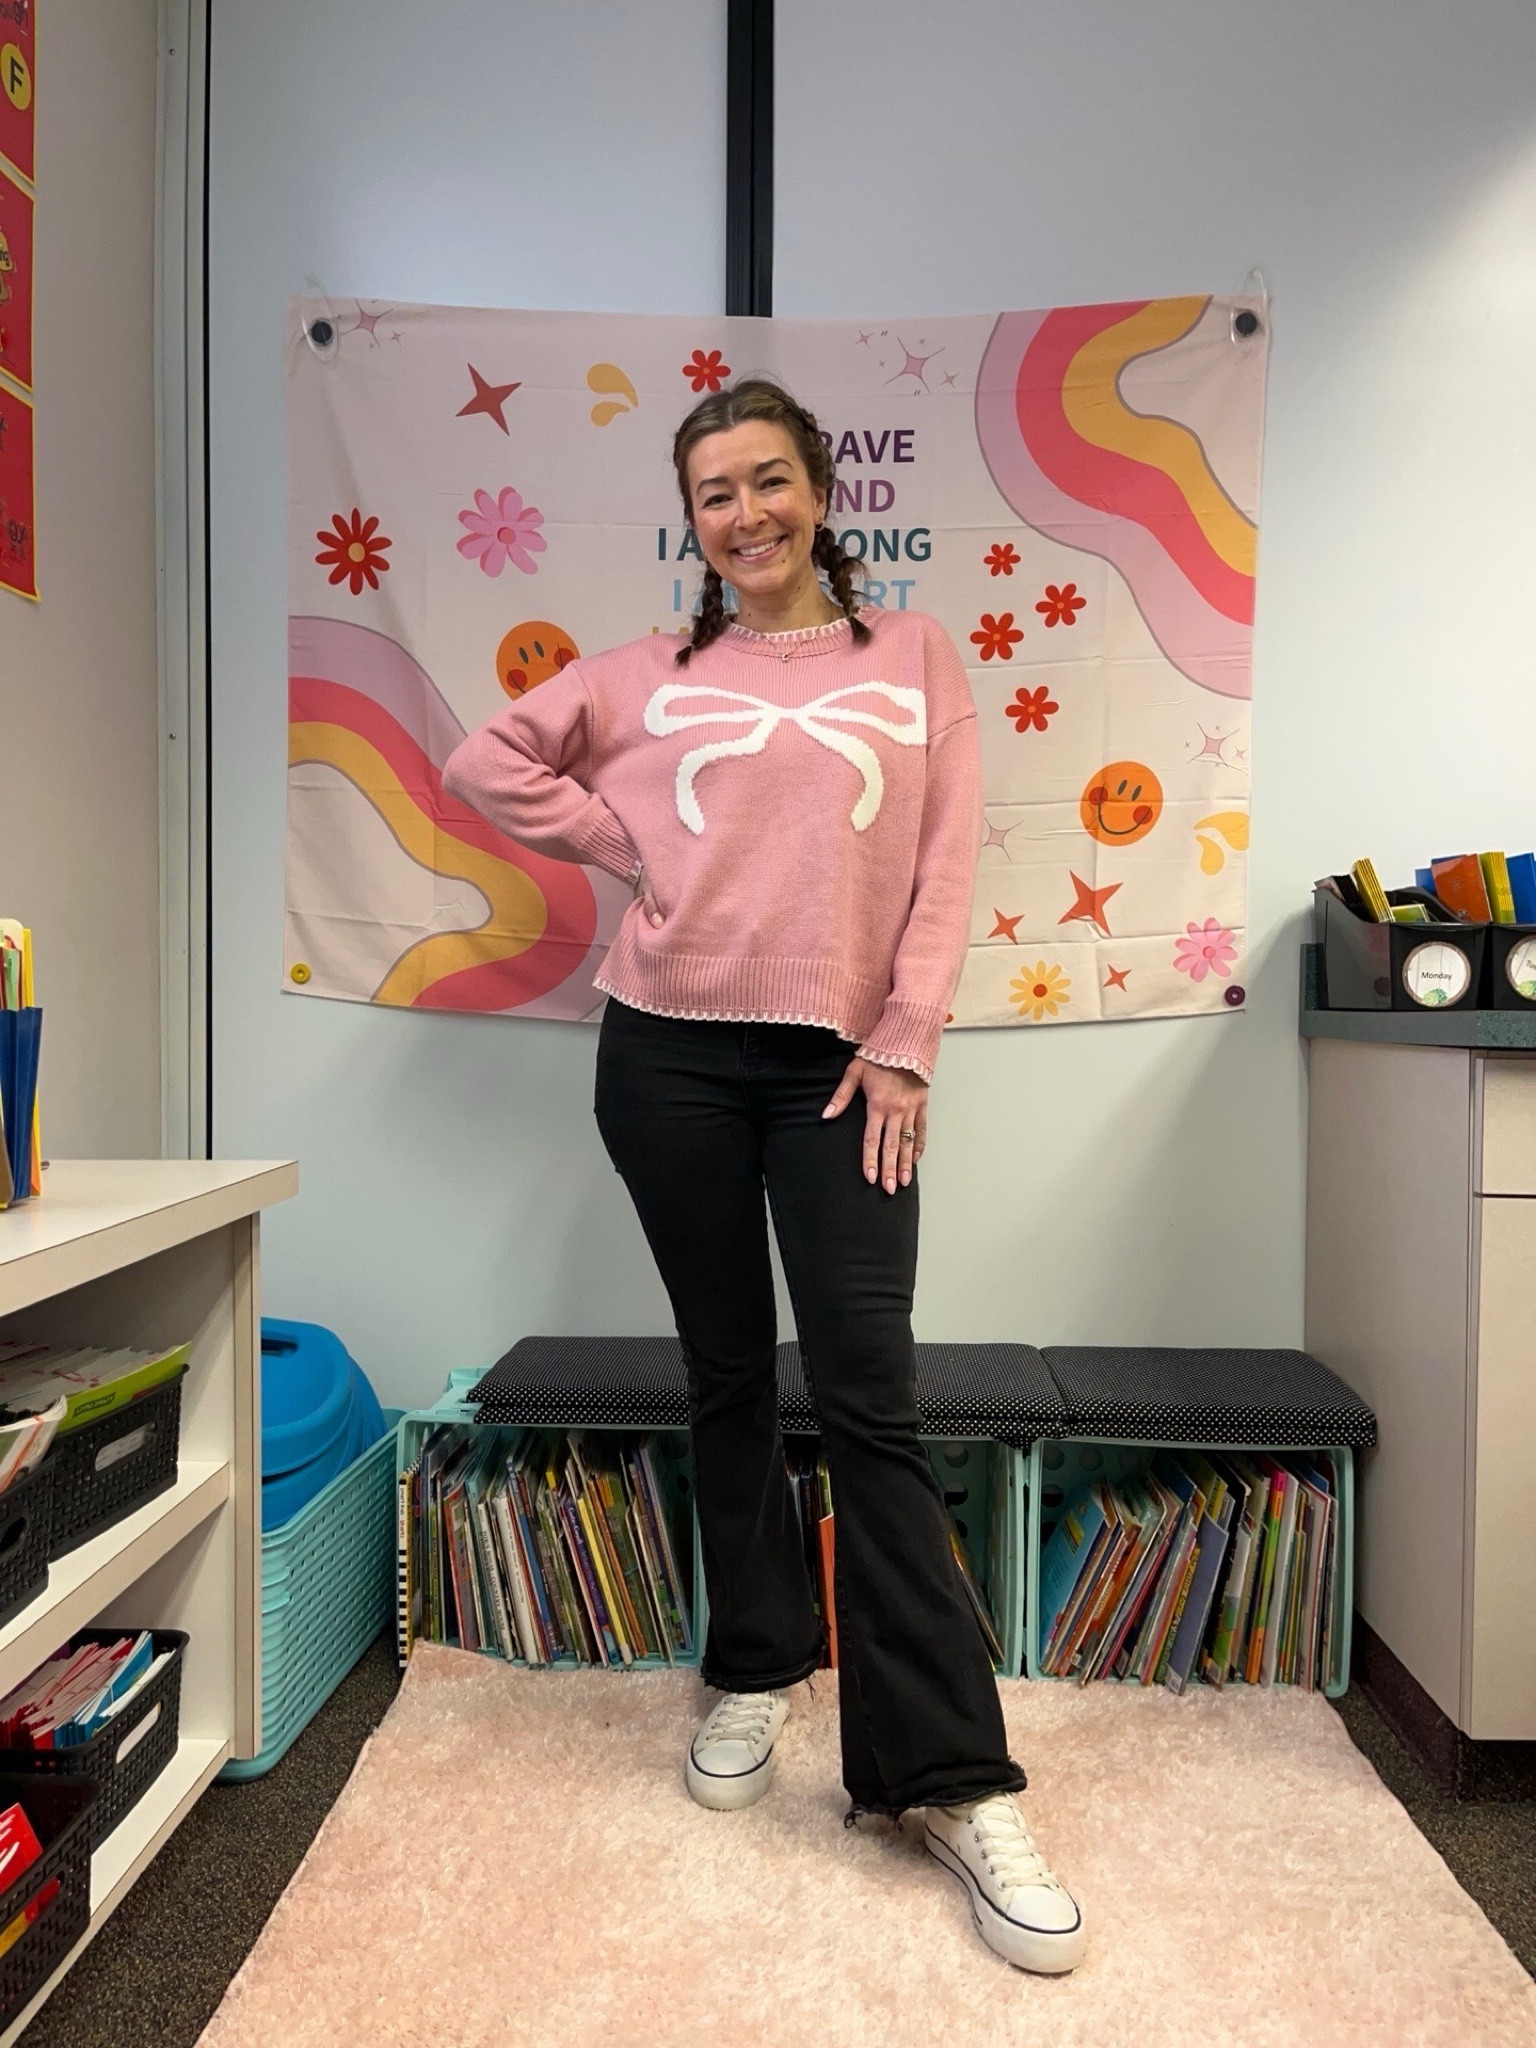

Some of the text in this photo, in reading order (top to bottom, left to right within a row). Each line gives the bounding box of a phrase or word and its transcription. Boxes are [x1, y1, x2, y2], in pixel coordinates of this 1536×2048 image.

[10, 55, 24, 94] F
[820, 430, 915, 463] AVE
[835, 479, 895, 513] ND
[658, 527, 931, 562] I A ONG
[673, 579, 682, 612] I
[1421, 972, 1452, 980] Monday
